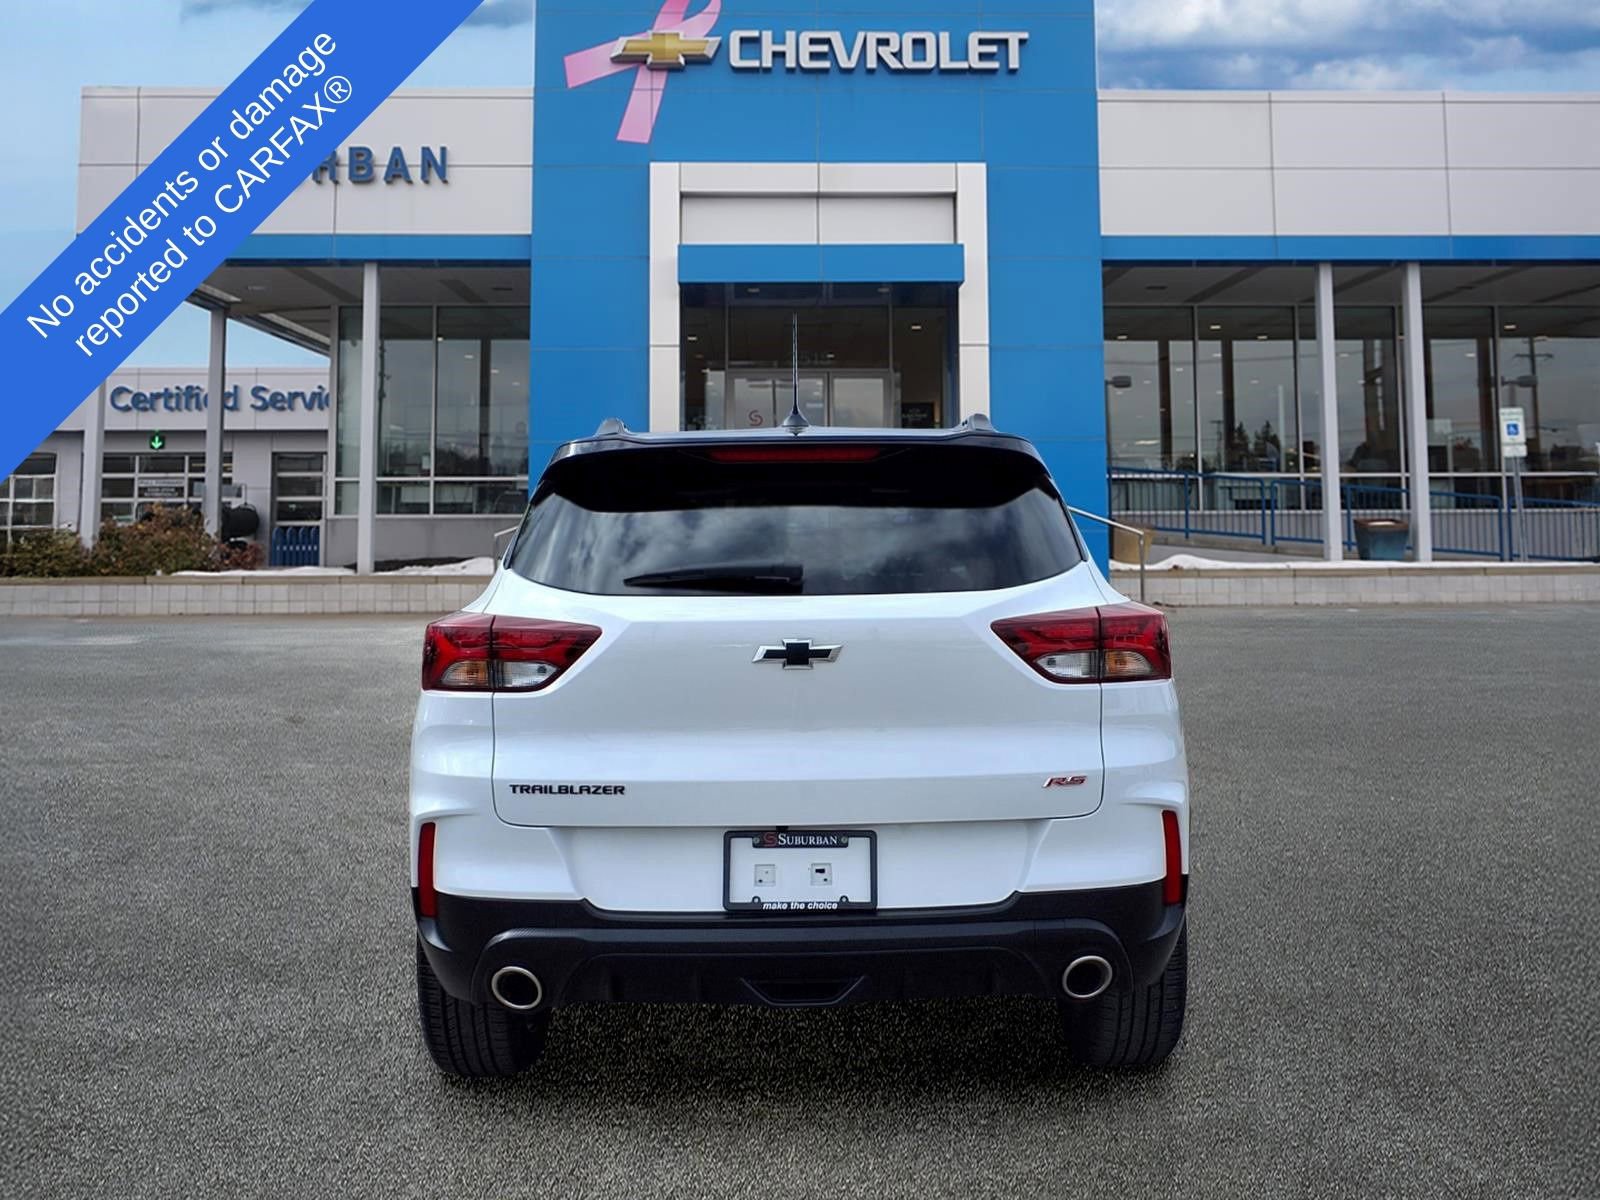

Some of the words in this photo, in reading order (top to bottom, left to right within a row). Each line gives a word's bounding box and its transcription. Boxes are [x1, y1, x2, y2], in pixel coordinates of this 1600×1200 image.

[729, 29, 1029, 71] CHEVROLET
[1042, 775, 1087, 788] RS
[509, 783, 625, 795] TRAILBLAZER
[778, 833, 838, 846] SUBURBAN
[762, 902, 788, 910] make
[790, 901, 805, 909] the
[807, 901, 838, 910] choice
